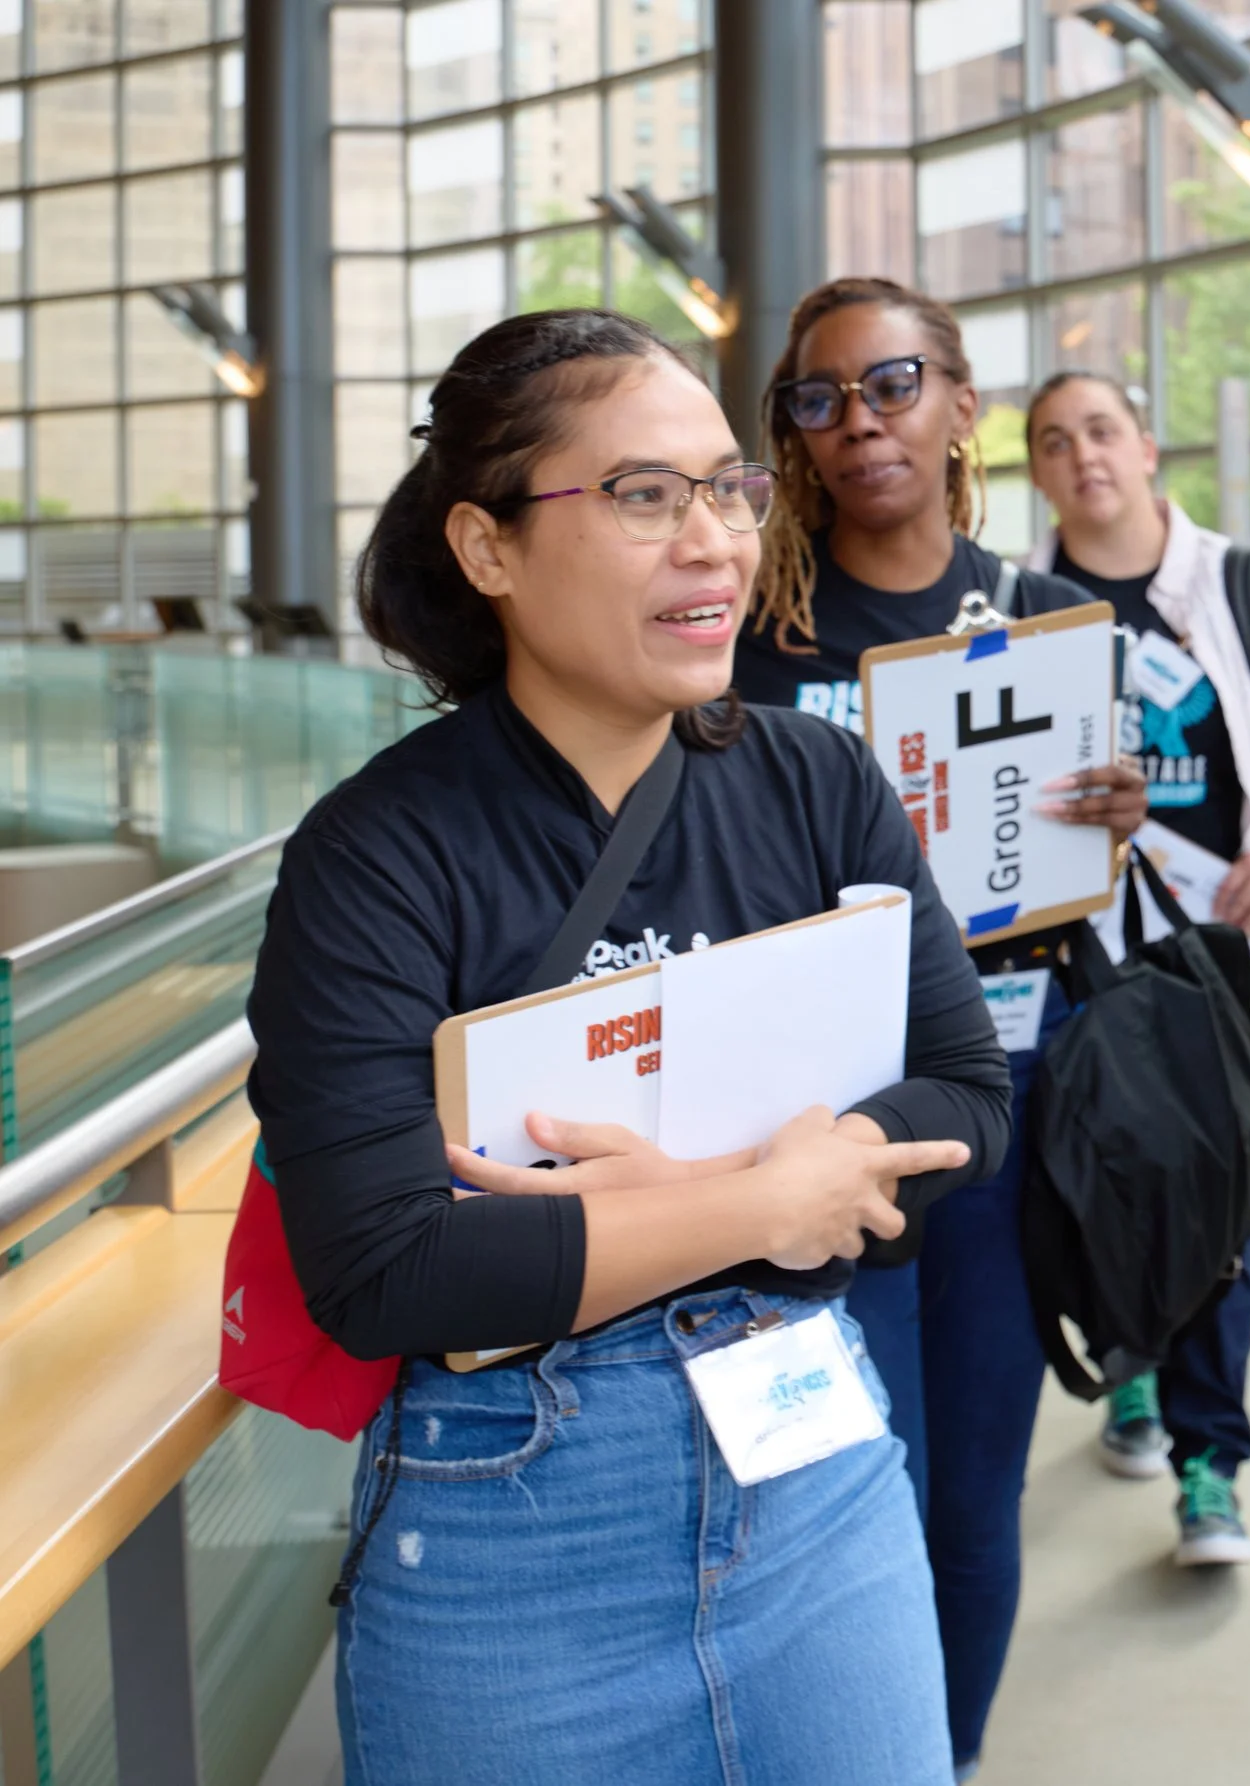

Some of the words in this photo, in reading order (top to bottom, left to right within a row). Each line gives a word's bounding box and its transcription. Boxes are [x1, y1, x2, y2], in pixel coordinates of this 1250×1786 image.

[956, 686, 1053, 749] F
[1077, 713, 1095, 764] West
[988, 764, 1029, 894] Group
[582, 927, 677, 974] peak
[586, 1004, 662, 1062] RISIN
